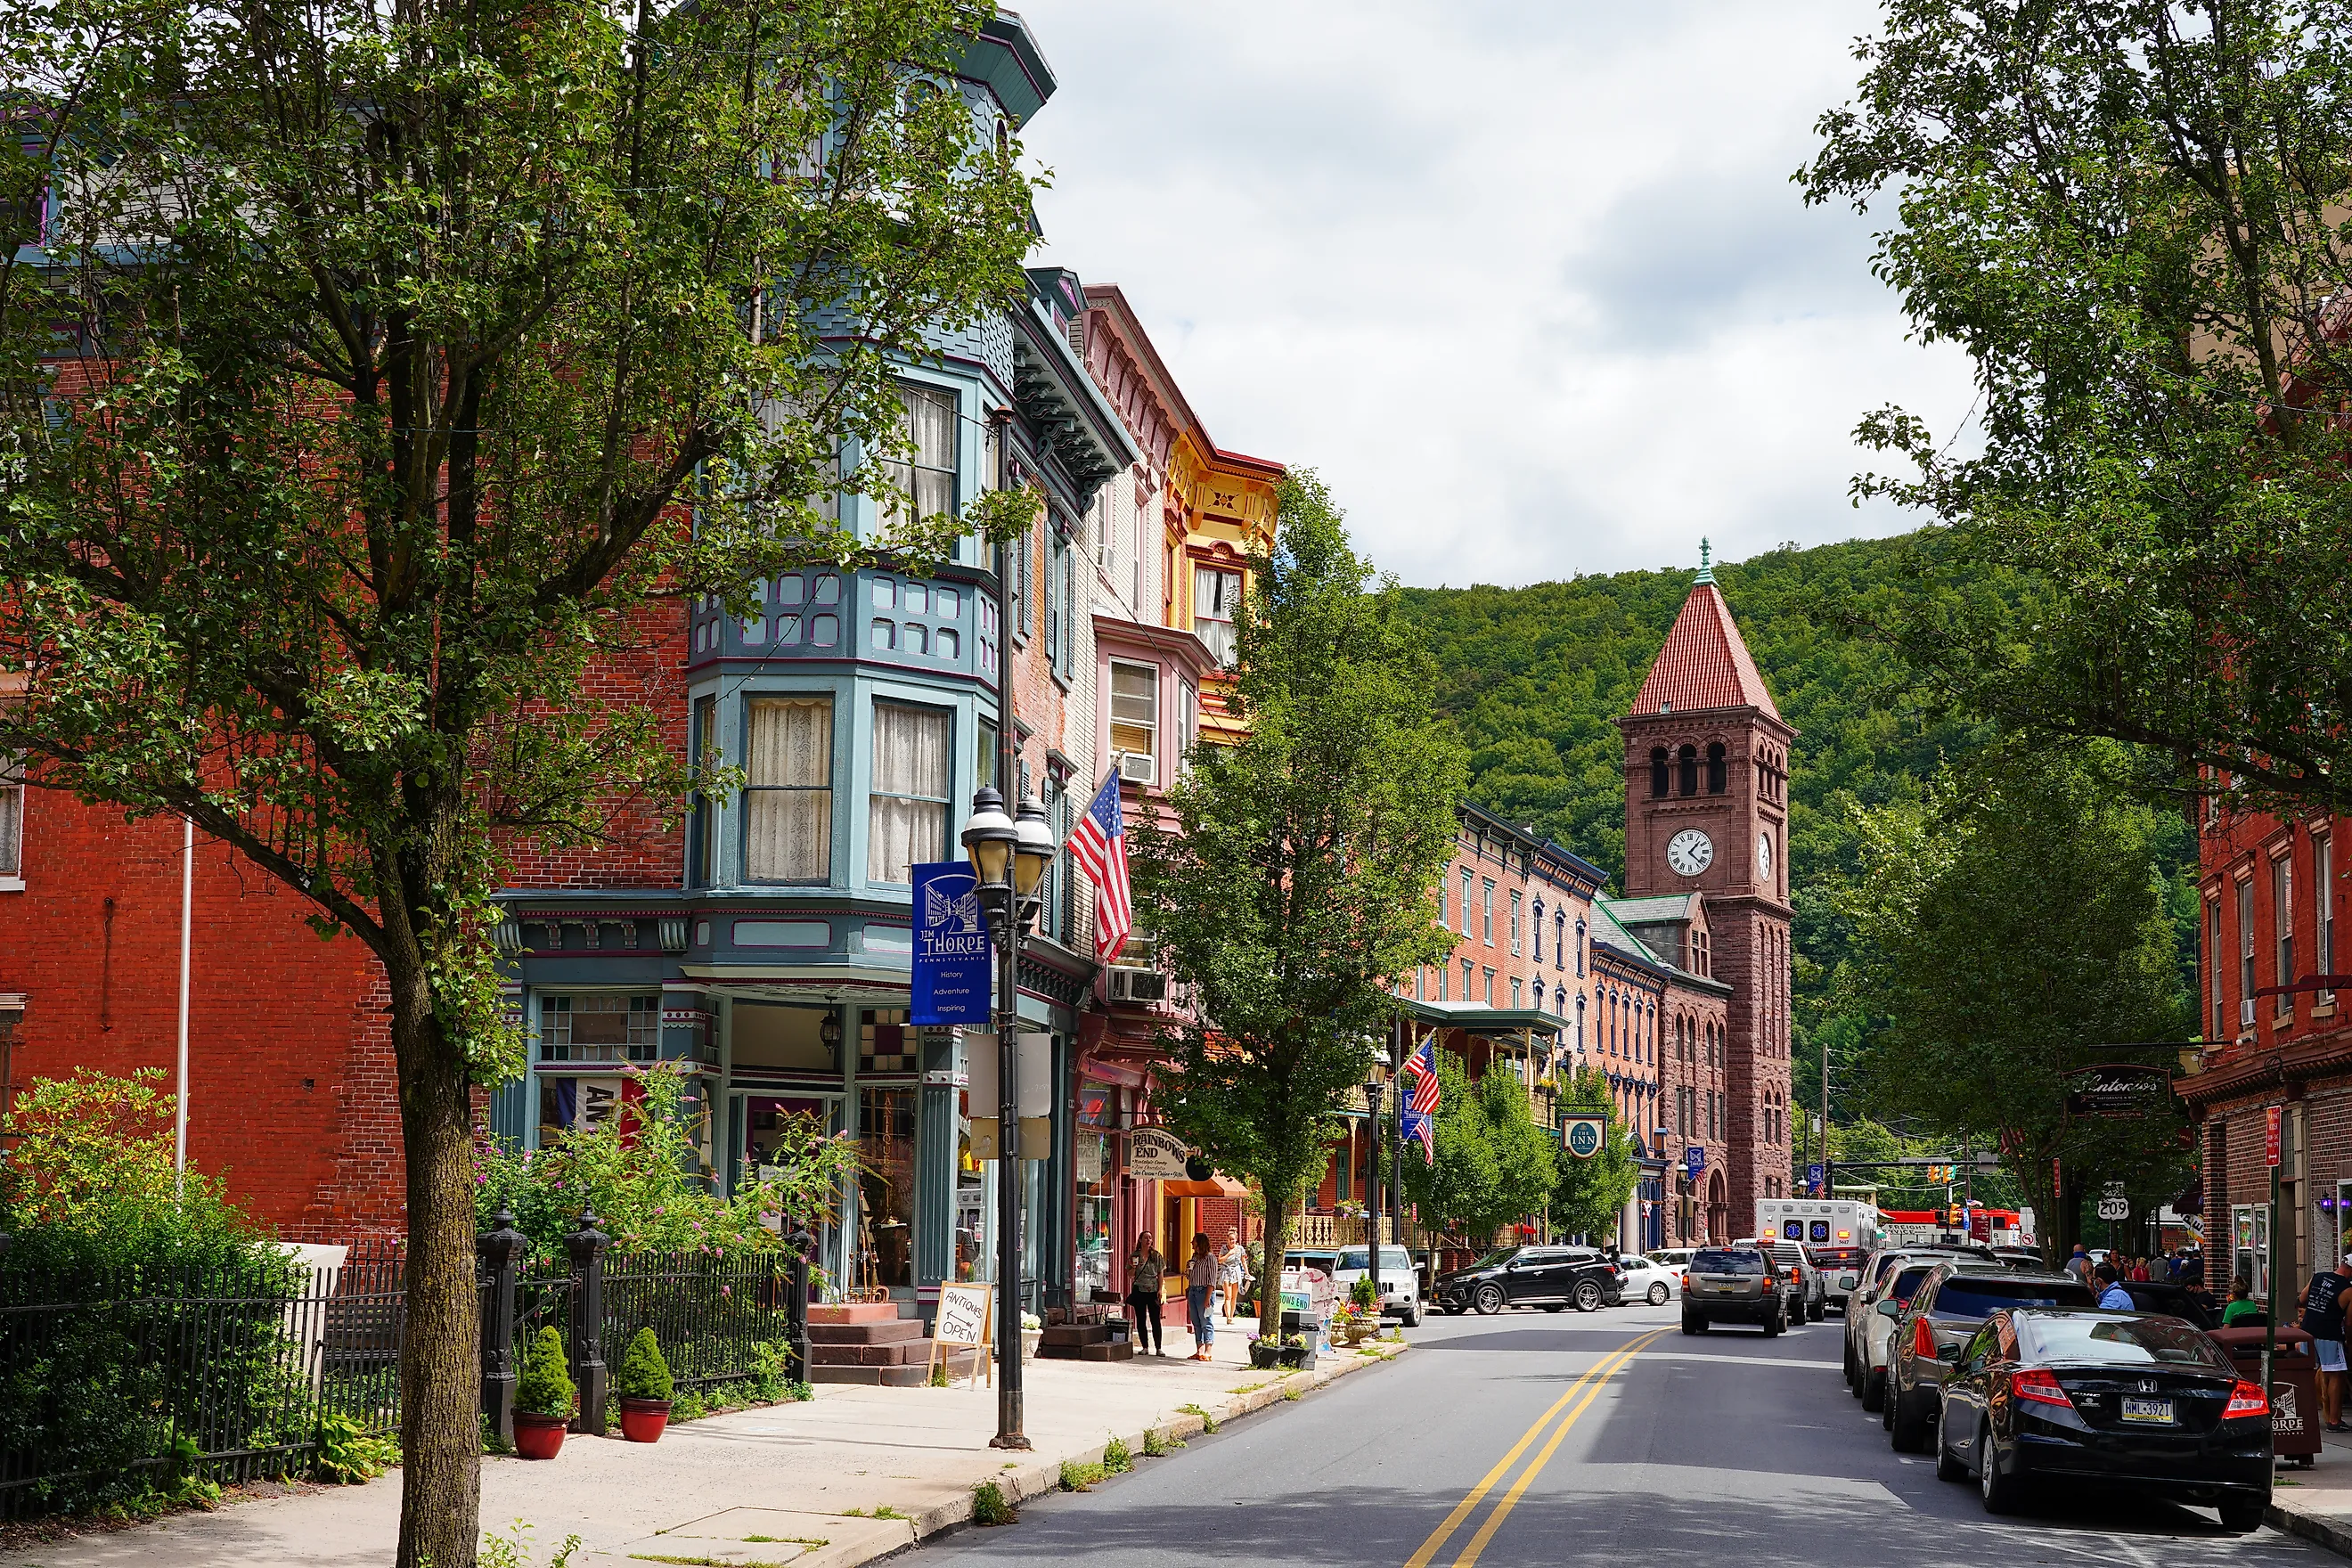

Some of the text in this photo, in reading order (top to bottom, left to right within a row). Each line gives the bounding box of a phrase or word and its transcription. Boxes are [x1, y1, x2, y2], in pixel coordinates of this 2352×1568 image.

[919, 930, 935, 941] JIM
[923, 930, 985, 957] THORPE
[940, 971, 964, 979] History
[933, 987, 970, 995] Adventure
[937, 1004, 966, 1013] Inspiring
[882, 1097, 892, 1173] ANTIQUES
[1572, 1135, 1595, 1145] INN
[1132, 1134, 1185, 1164] RAINBOWS
[1135, 1147, 1158, 1158] END
[2100, 1202, 2126, 1215] 209
[945, 1291, 983, 1319] ANTIQUES
[1295, 1297, 1308, 1310] END
[943, 1321, 977, 1343] OPEN
